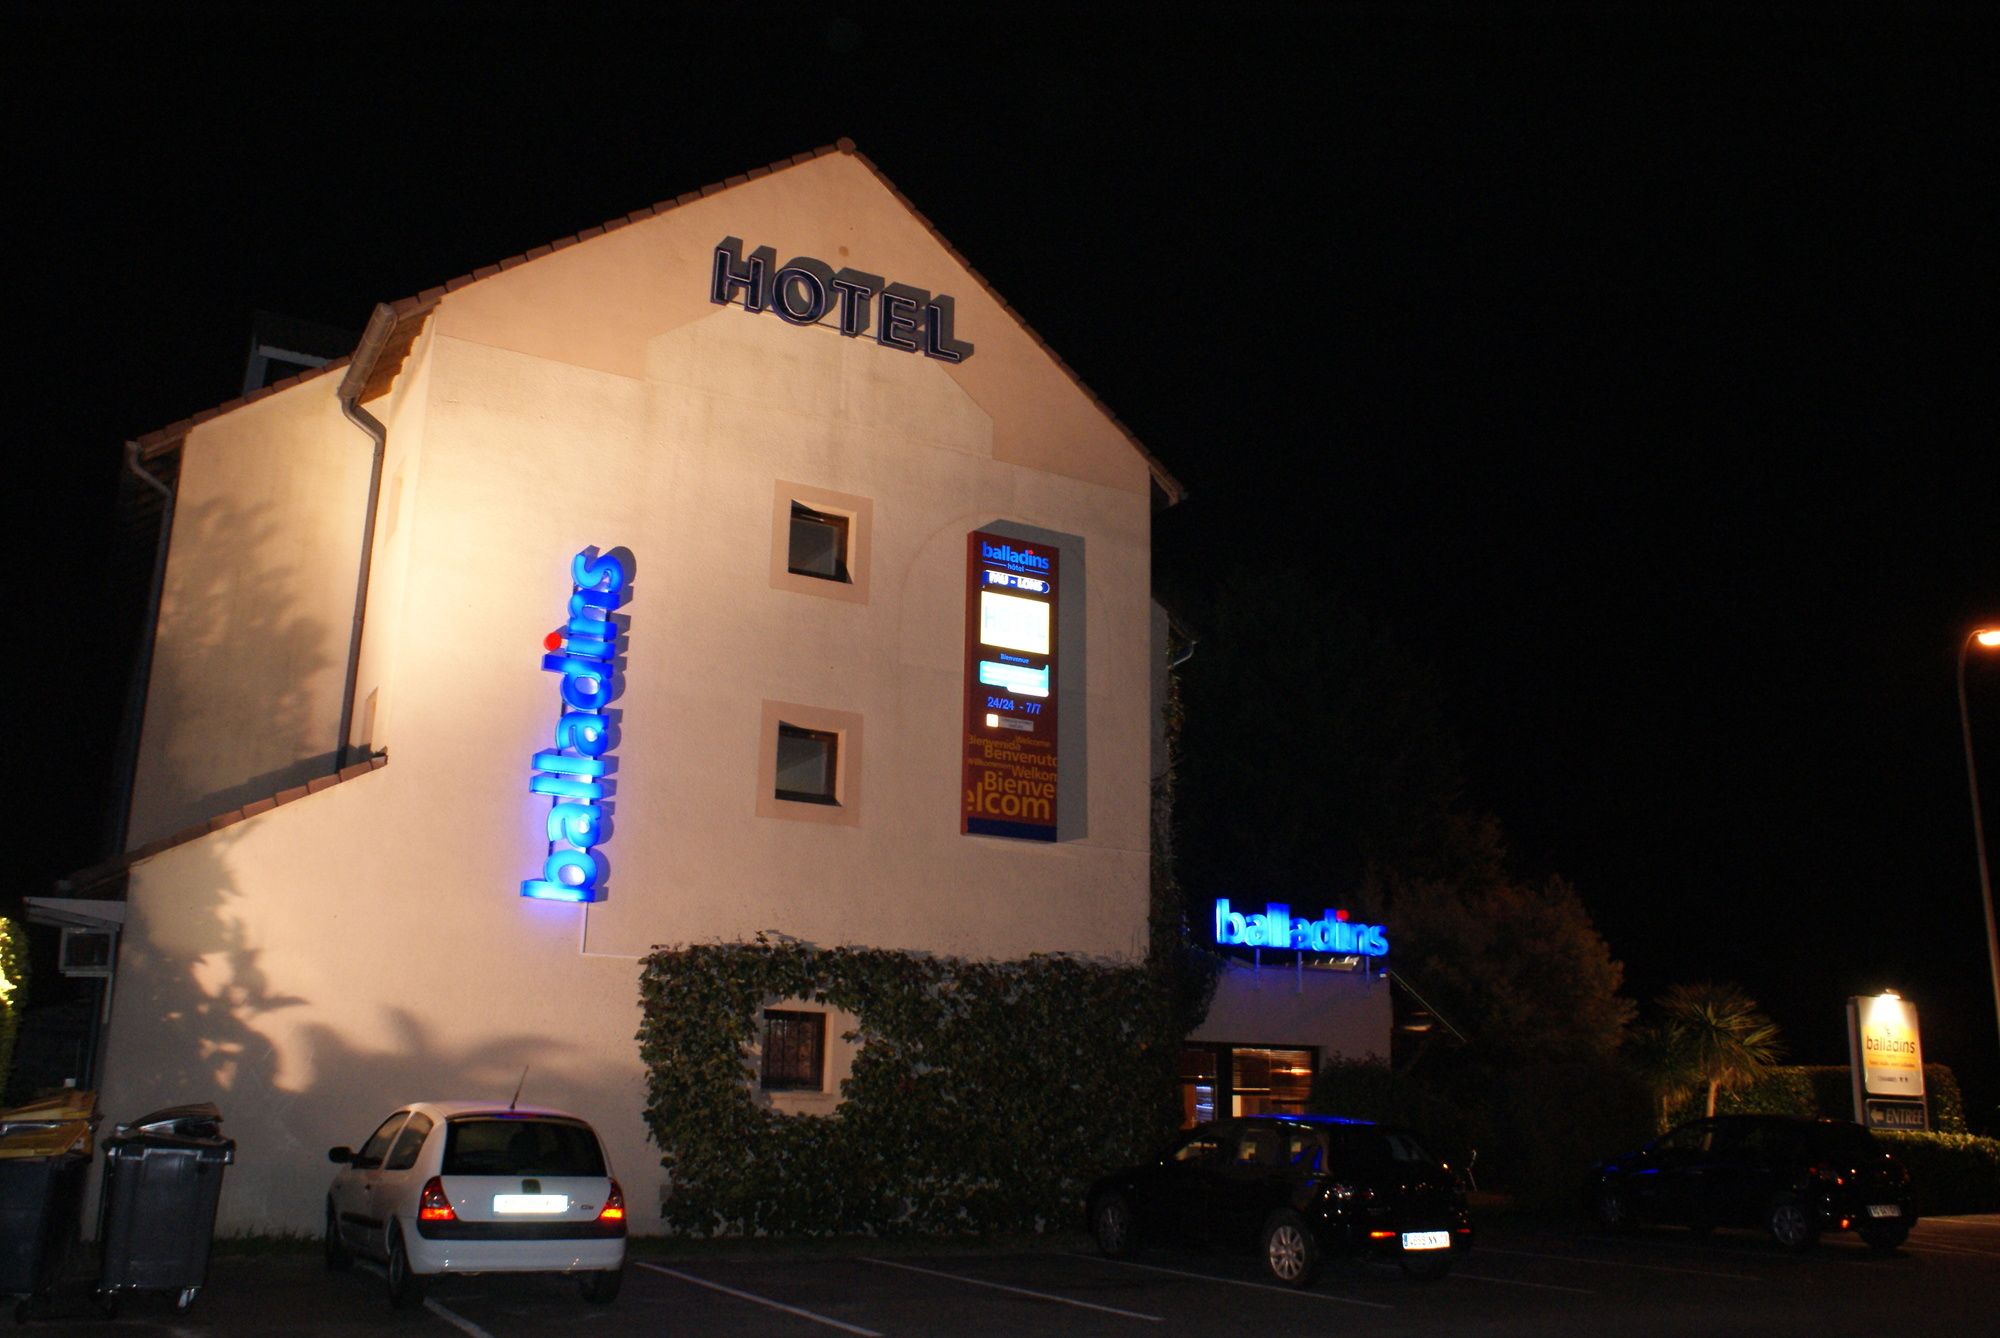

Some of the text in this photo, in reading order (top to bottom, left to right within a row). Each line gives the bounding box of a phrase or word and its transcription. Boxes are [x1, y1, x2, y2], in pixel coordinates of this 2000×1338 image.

[710, 246, 961, 364] HOTEL
[982, 541, 1050, 569] balladins
[987, 696, 1014, 711] 24/24
[1026, 702, 1041, 714] 7/7
[520, 552, 624, 903] balladins
[985, 771, 1055, 798] Bienve
[1216, 898, 1390, 957] balladins
[1866, 1036, 1916, 1054] balladins
